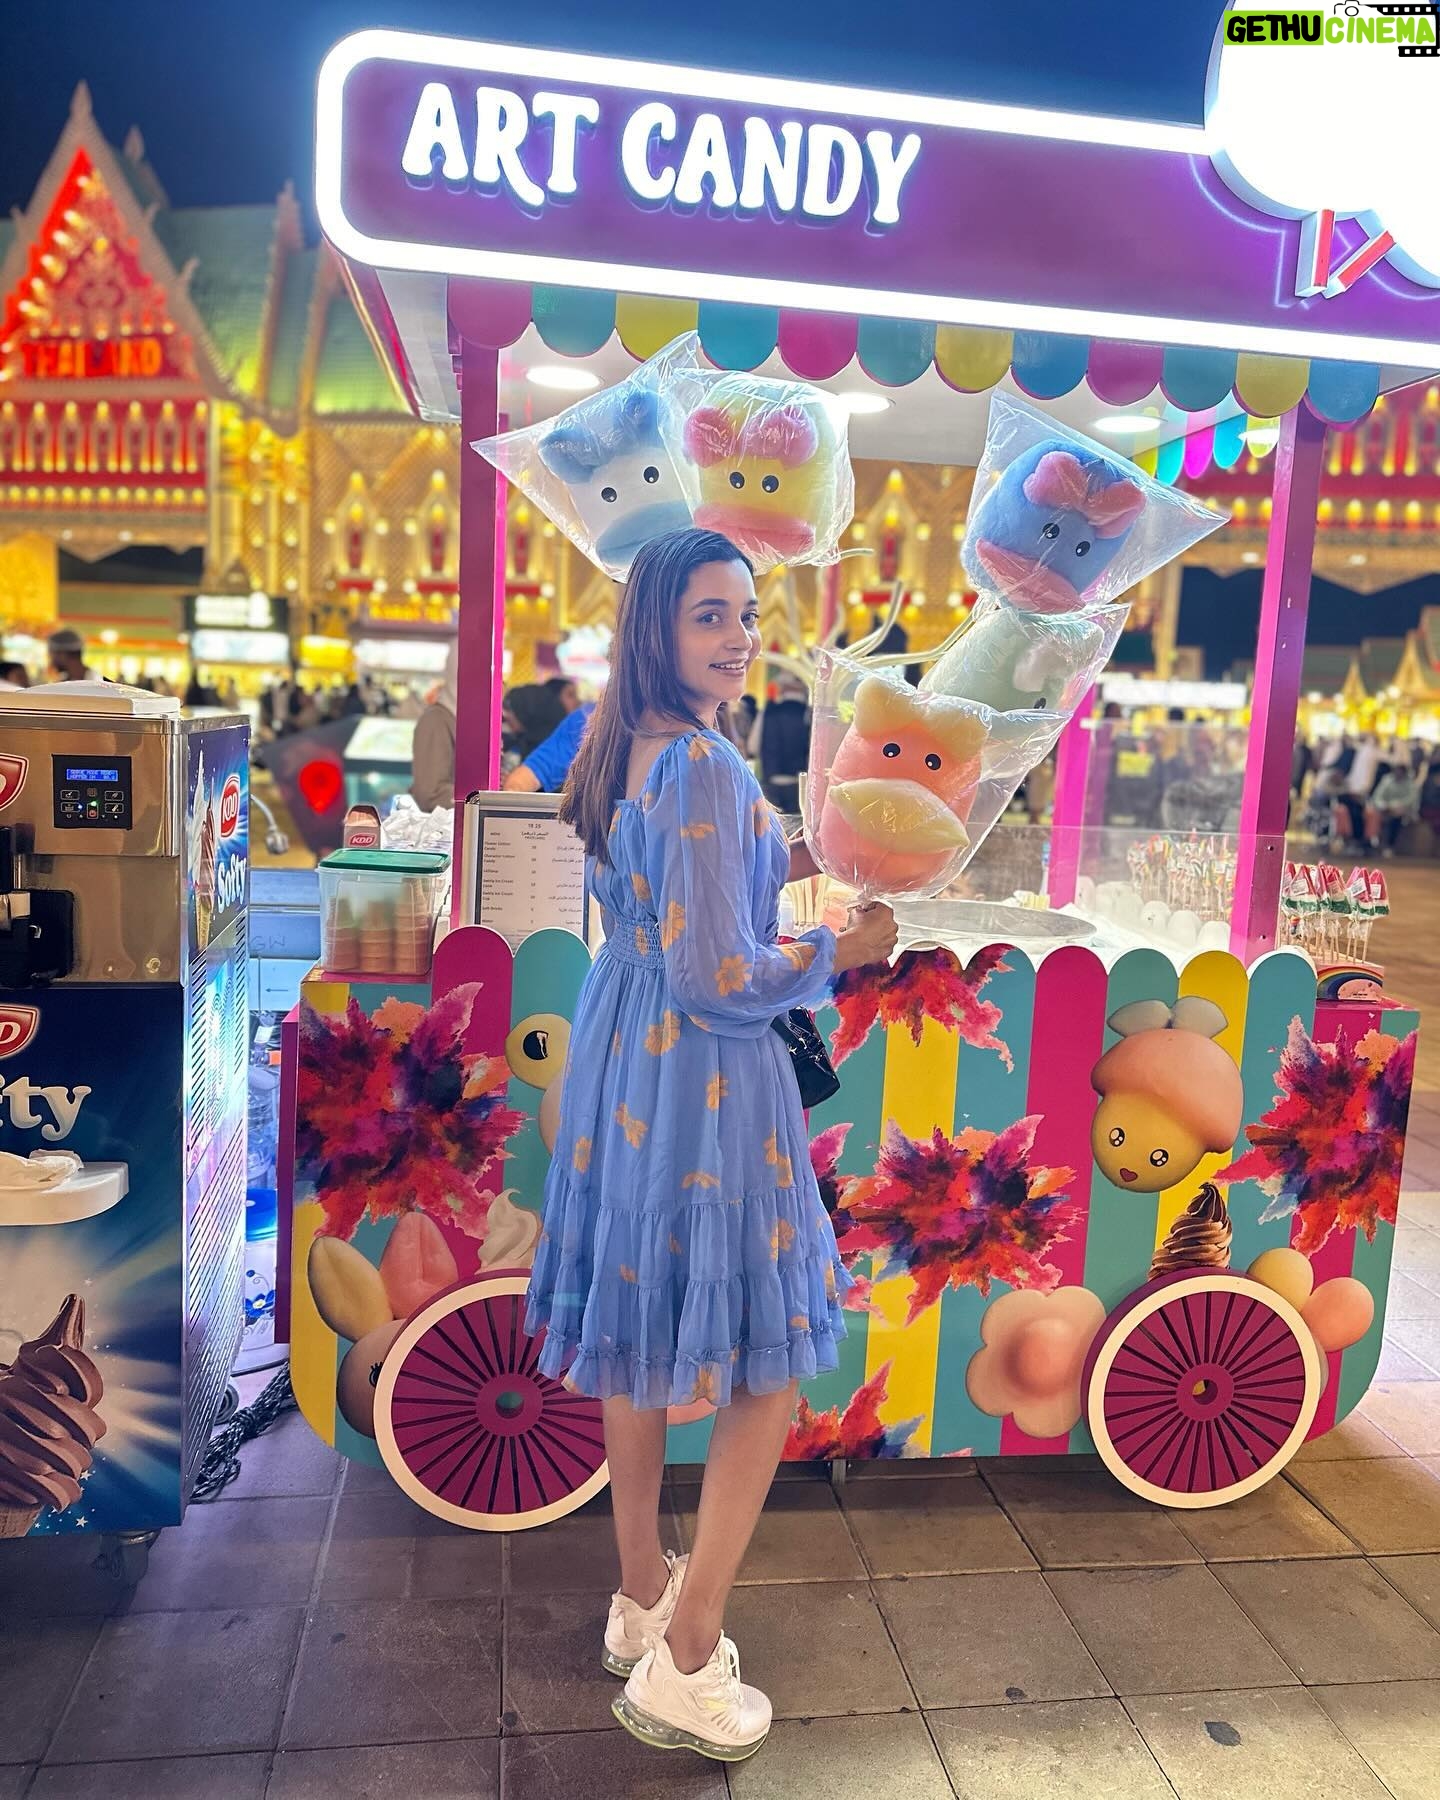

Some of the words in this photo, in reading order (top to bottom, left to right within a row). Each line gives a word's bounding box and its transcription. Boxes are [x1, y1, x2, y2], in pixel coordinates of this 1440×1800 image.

[401, 82, 600, 207] ART
[621, 102, 922, 225] CANDY
[222, 792, 239, 825] KDD
[351, 836, 373, 844] KDD
[217, 853, 247, 914] Softy
